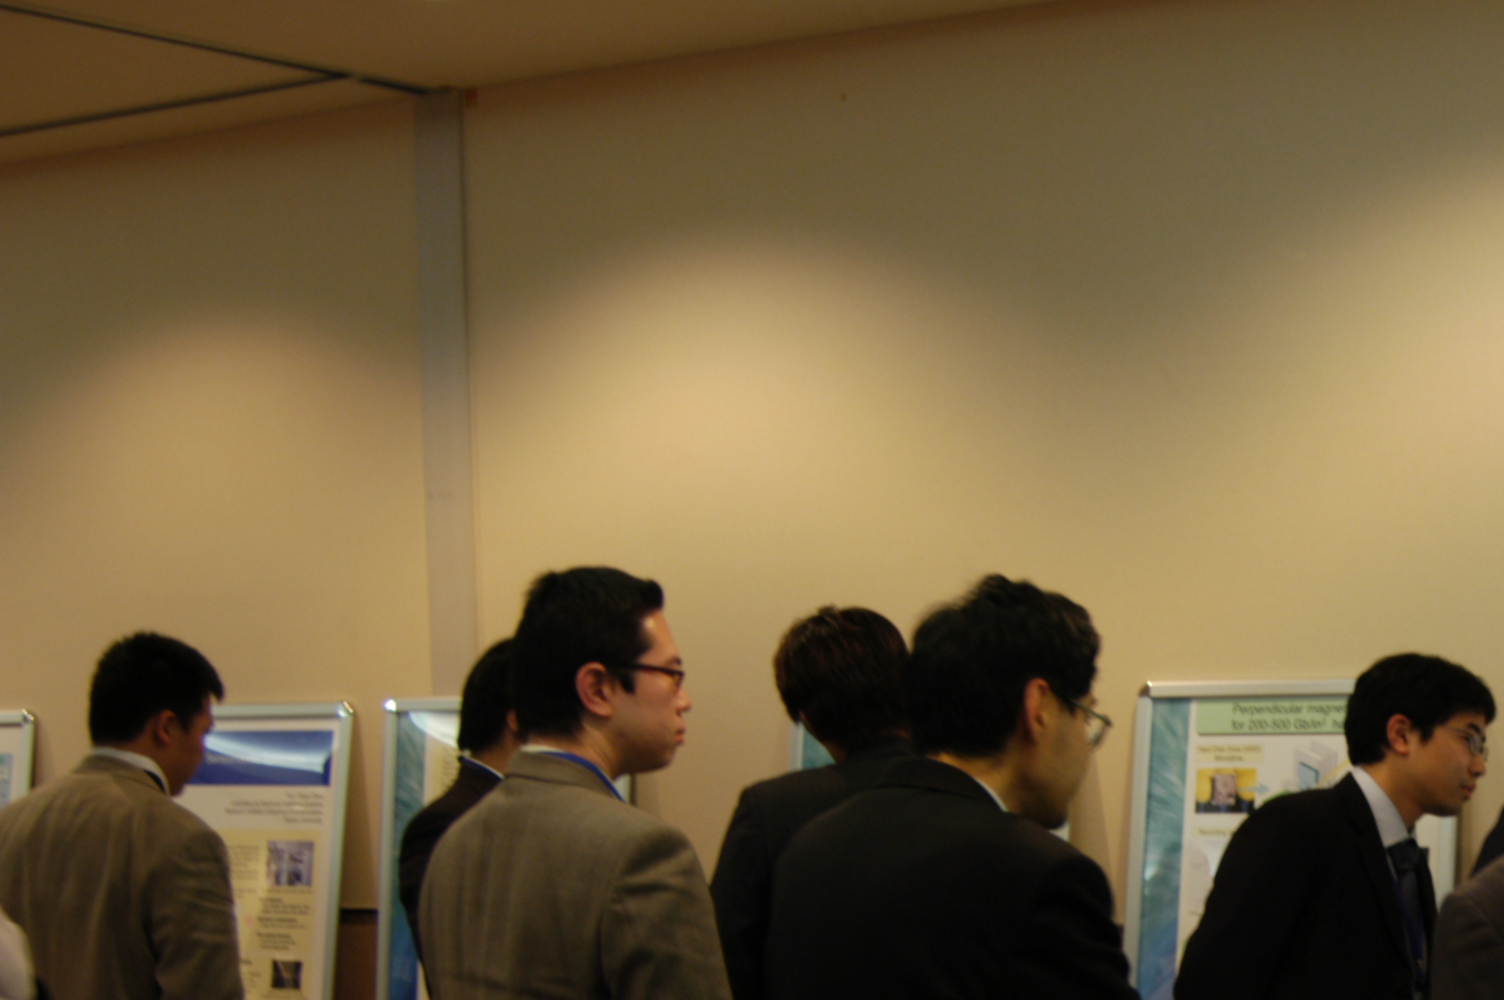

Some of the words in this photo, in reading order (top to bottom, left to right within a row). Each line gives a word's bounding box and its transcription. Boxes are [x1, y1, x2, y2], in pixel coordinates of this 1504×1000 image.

[1232, 703, 1303, 716] Perpendicular
[1306, 704, 1346, 716] magne
[1231, 718, 1245, 730] for
